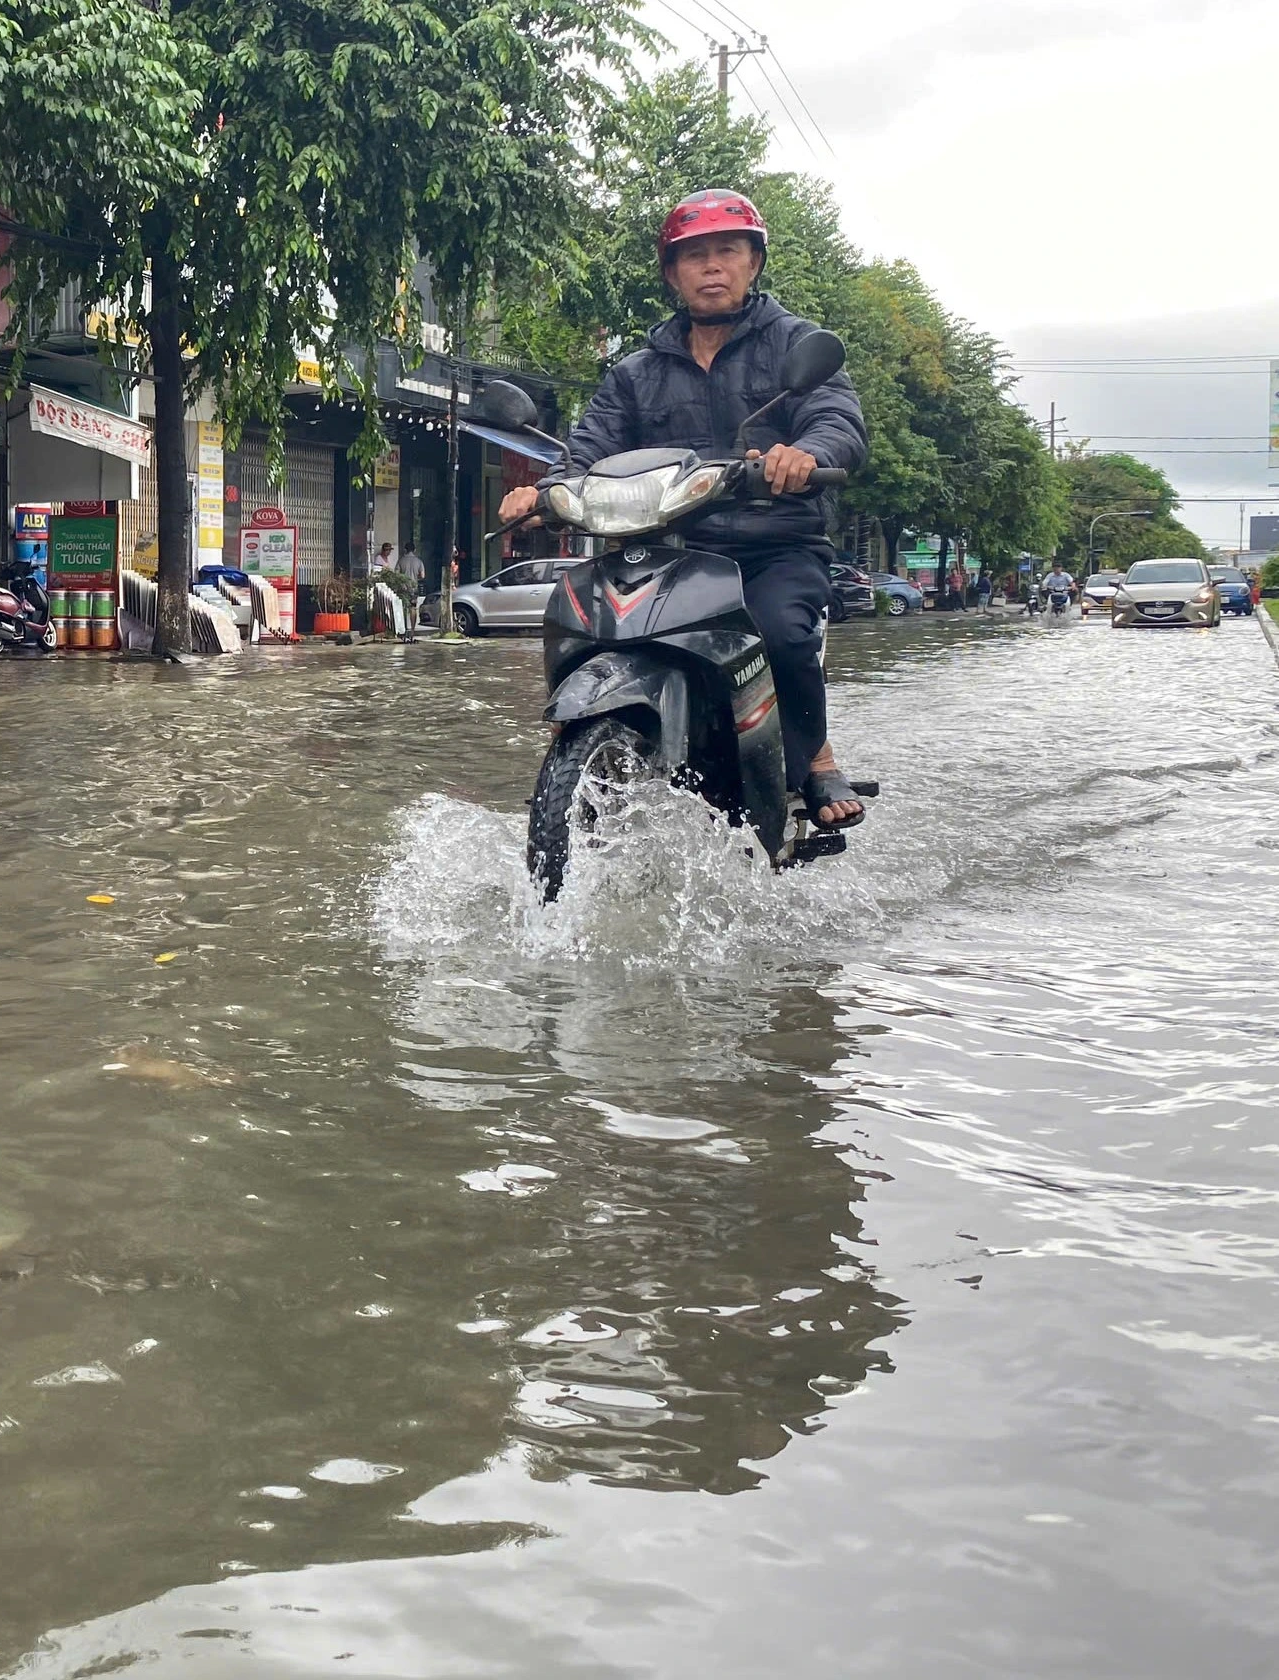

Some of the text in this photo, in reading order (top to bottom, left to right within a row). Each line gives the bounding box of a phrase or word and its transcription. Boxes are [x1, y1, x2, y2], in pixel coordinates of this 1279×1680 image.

[23, 514, 46, 527] ALEX
[256, 512, 278, 520] KOVA
[263, 544, 292, 552] CLEAR
[734, 653, 765, 686] YAMAHA
